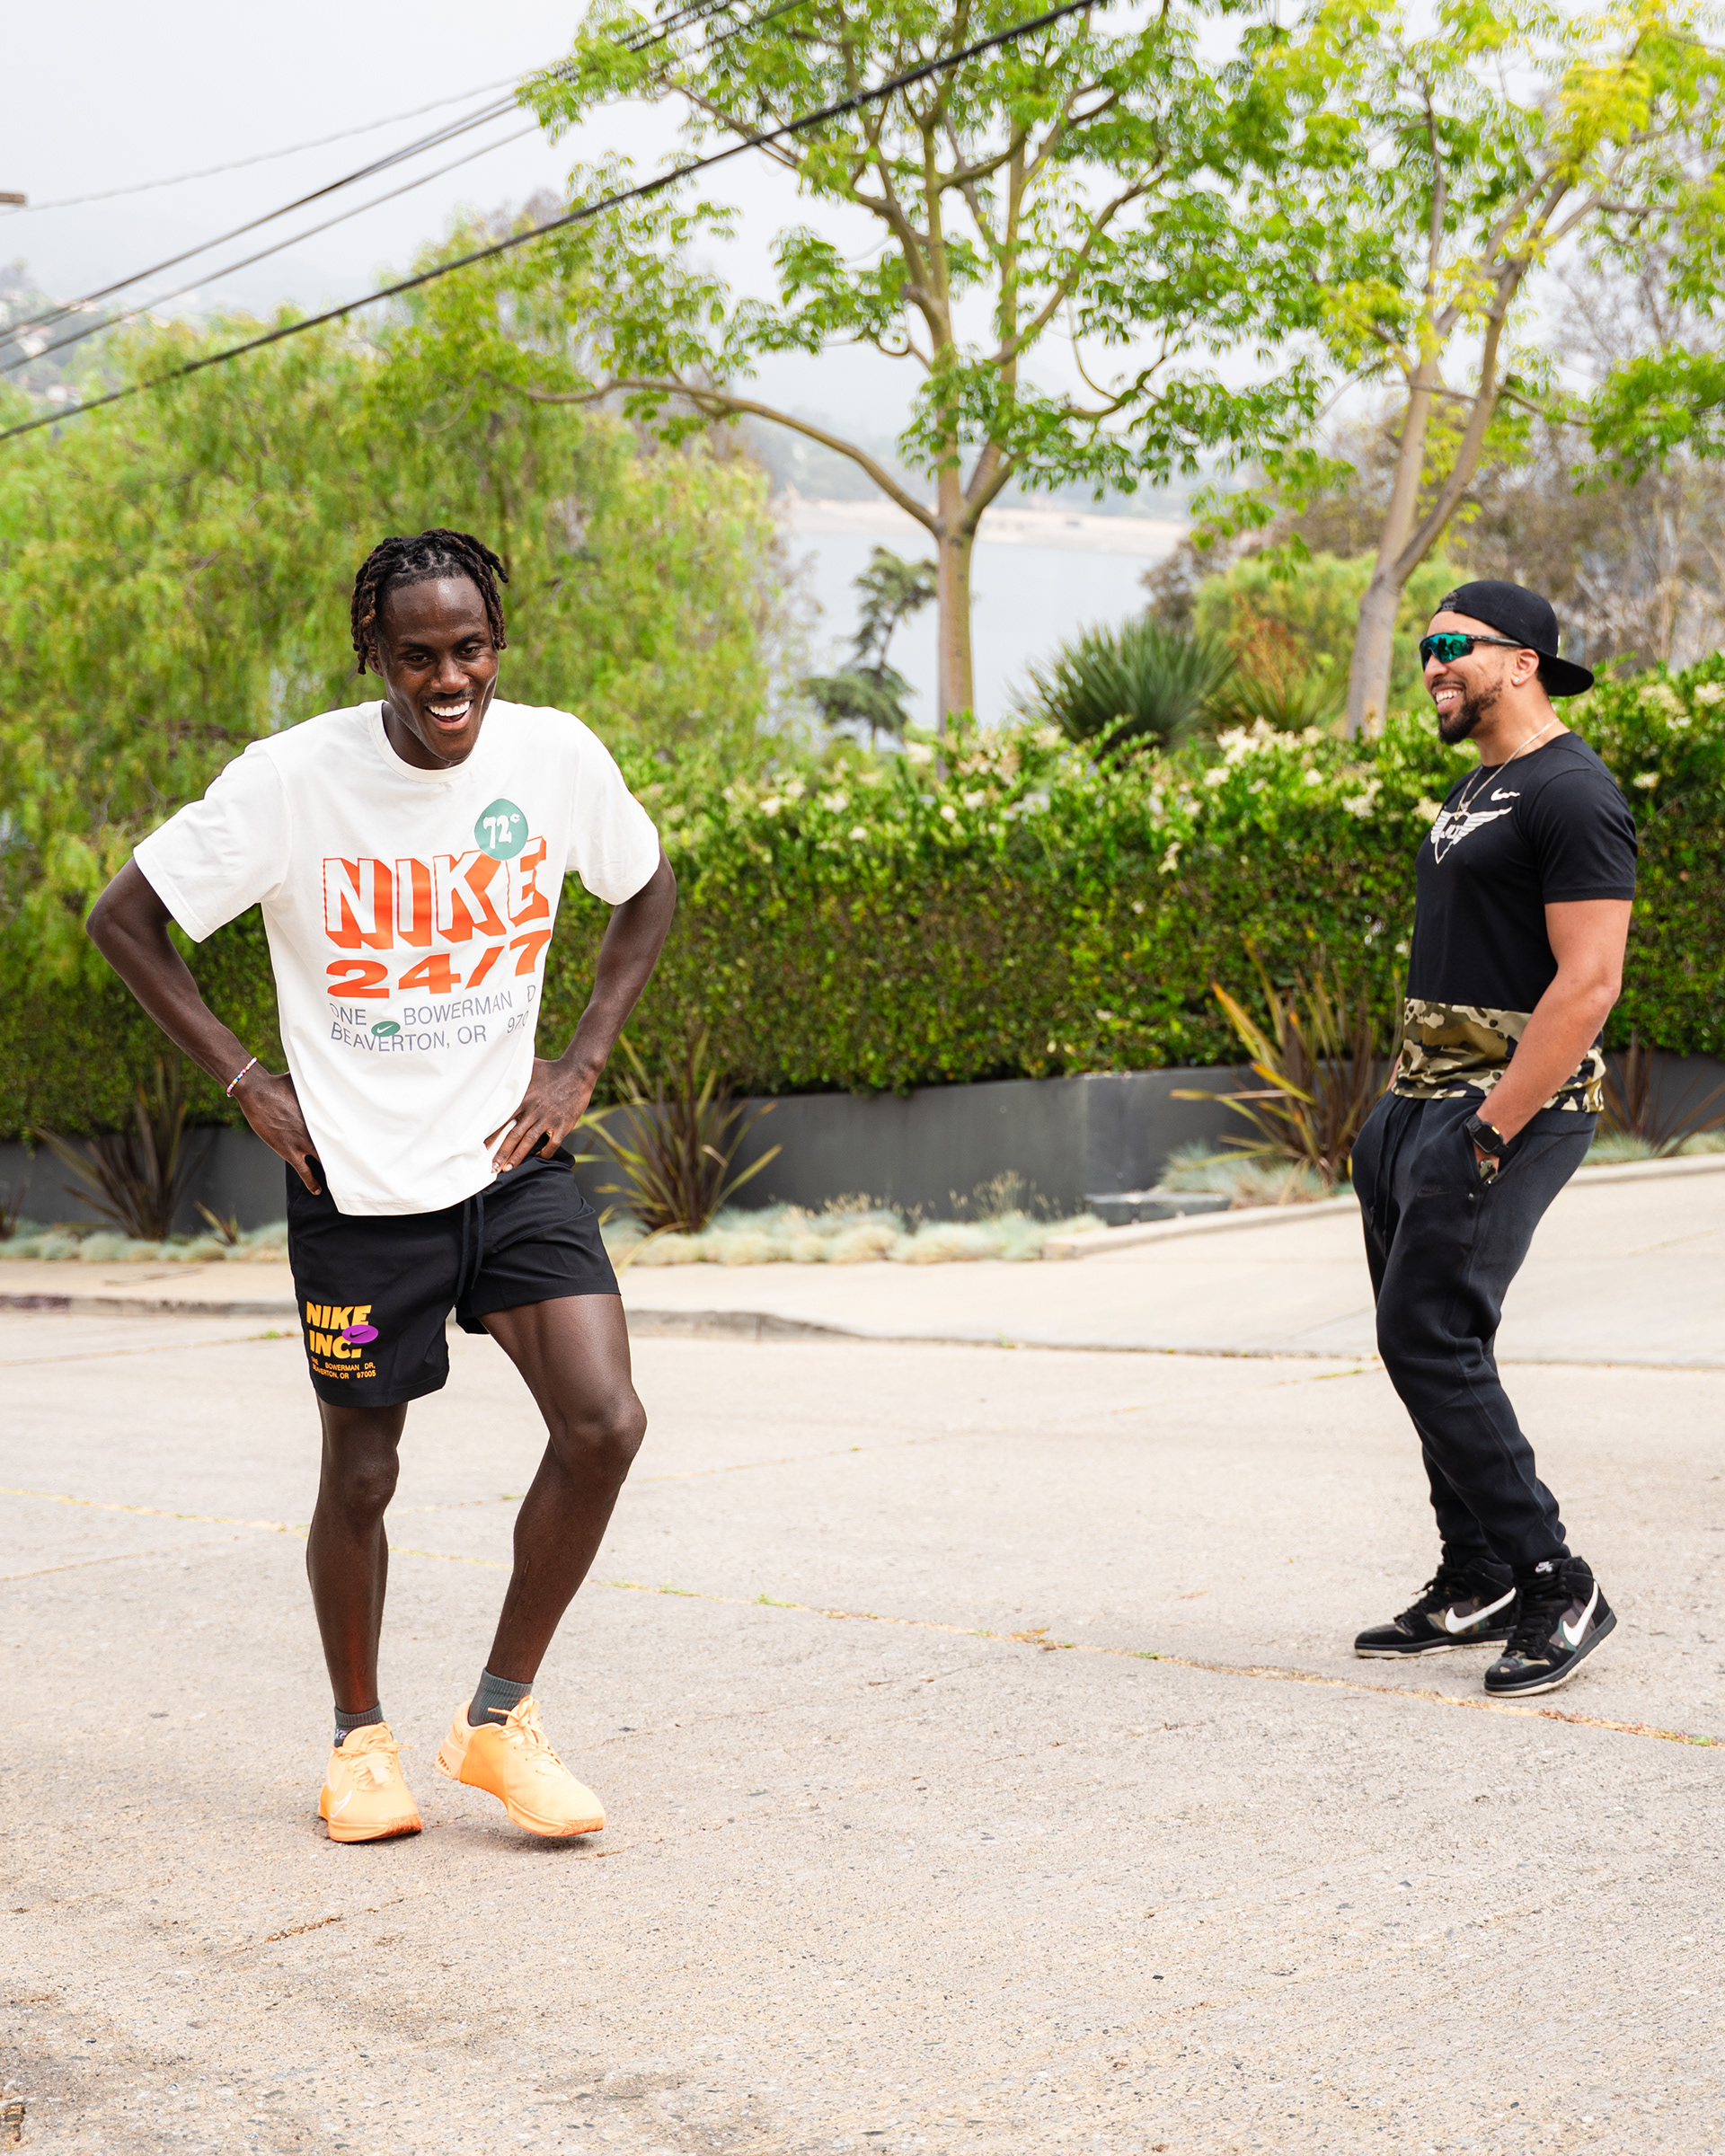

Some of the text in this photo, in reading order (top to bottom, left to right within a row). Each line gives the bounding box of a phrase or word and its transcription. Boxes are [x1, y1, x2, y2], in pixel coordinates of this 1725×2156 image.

[323, 835, 551, 950] NIKE
[325, 929, 552, 999] 24/7
[329, 1003, 367, 1026] ONE
[403, 990, 513, 1026] BOWERMAN
[331, 1021, 450, 1052] BEAVERTON,
[457, 1025, 487, 1045] OR
[306, 1301, 372, 1330] NIKE
[309, 1330, 362, 1359] INC.
[324, 1362, 360, 1371] BOWERMAN
[364, 1362, 376, 1370] DR.
[356, 1370, 376, 1379] 97005
